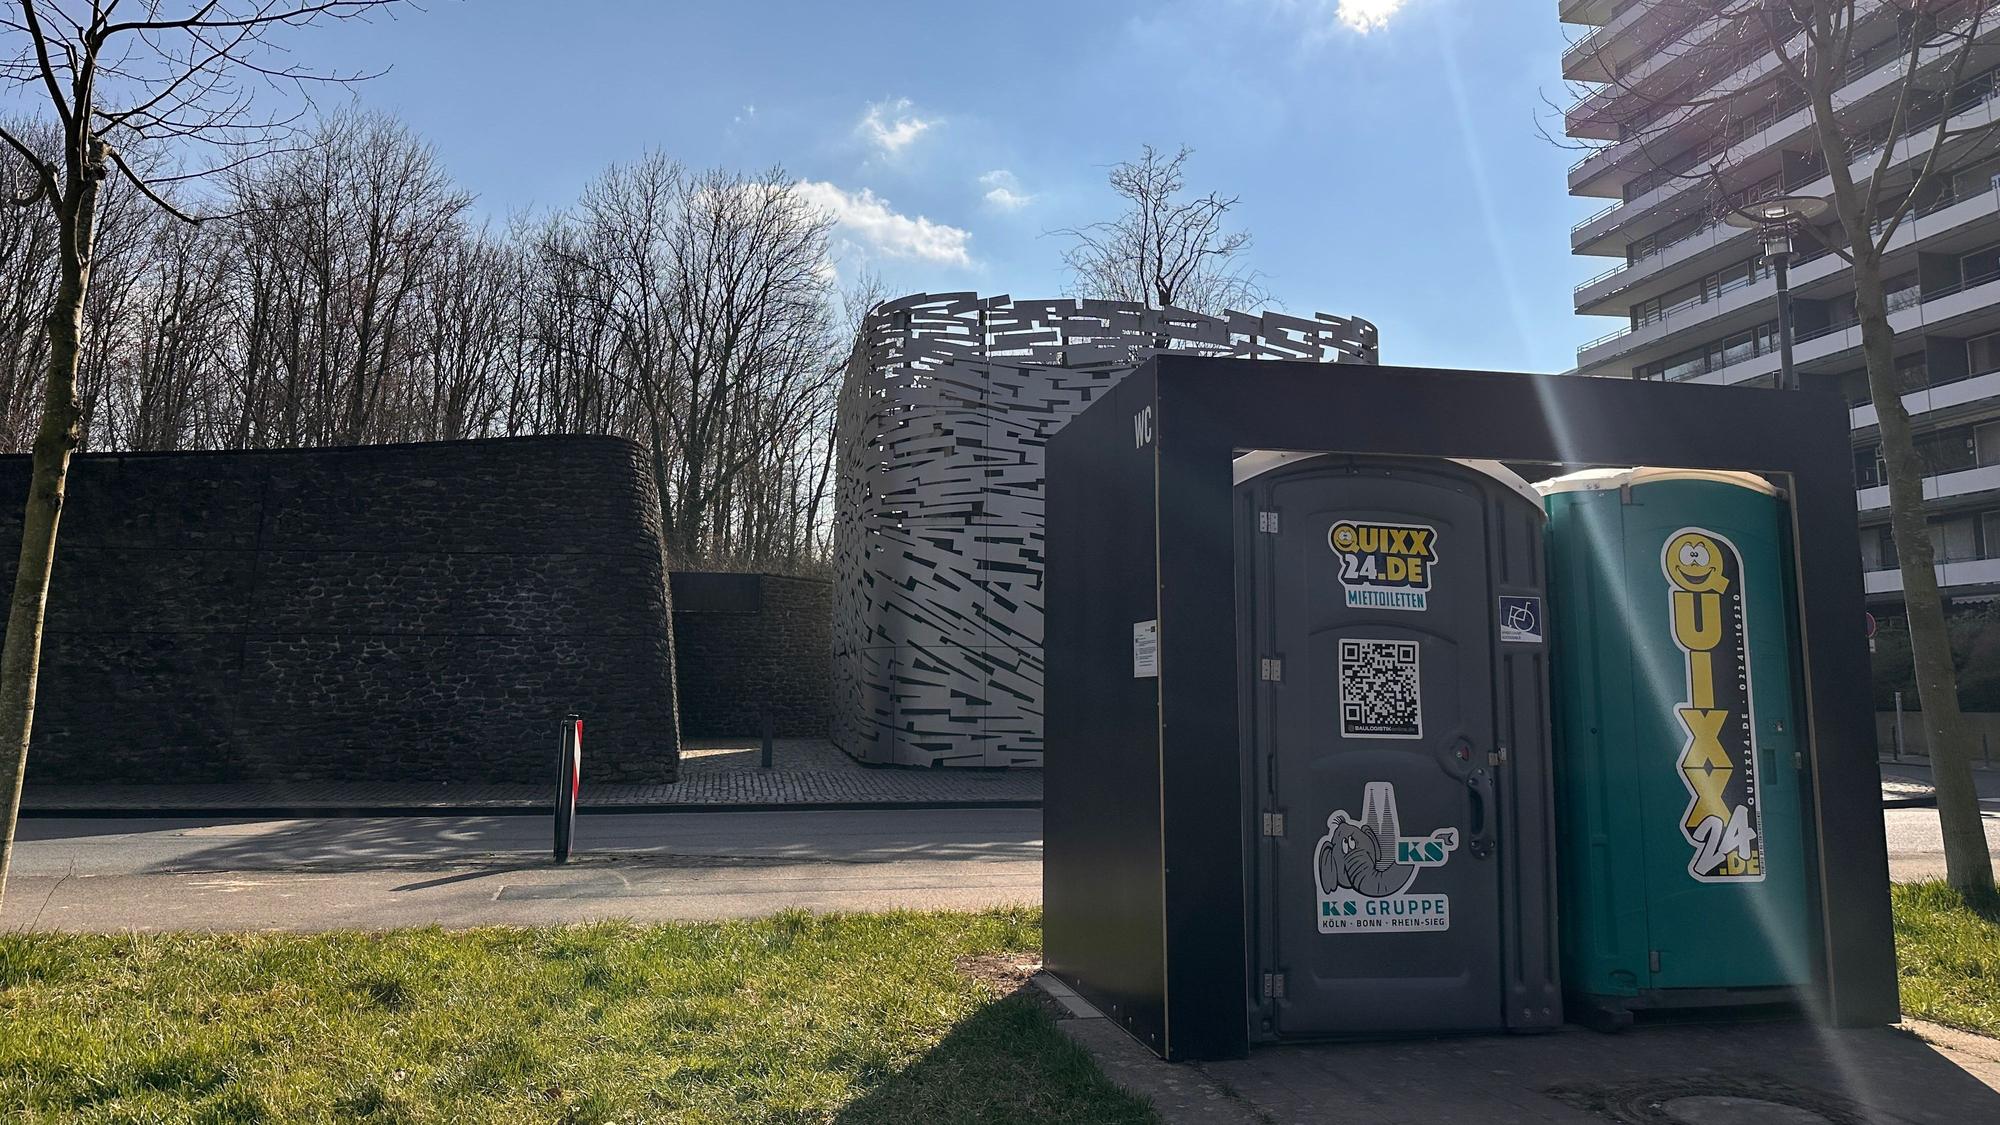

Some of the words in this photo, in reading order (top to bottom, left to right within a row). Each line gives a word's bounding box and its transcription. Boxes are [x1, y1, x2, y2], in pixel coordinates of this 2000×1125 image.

[1134, 405, 1152, 449] WC
[1333, 526, 1429, 555] QUIXX
[1344, 553, 1422, 582] 24.DE
[1348, 590, 1424, 608] MIETTOILETTEN
[1733, 594, 1746, 690] 02241-16520
[1741, 713, 1754, 805] QUIXX24.DE
[1398, 841, 1444, 862] KS
[1322, 900, 1358, 916] KS
[1365, 899, 1445, 916] GRUPPE
[1322, 918, 1347, 928] KÖLN
[1356, 918, 1382, 927] BONN
[1391, 917, 1445, 927] RHEIN-SIEG
